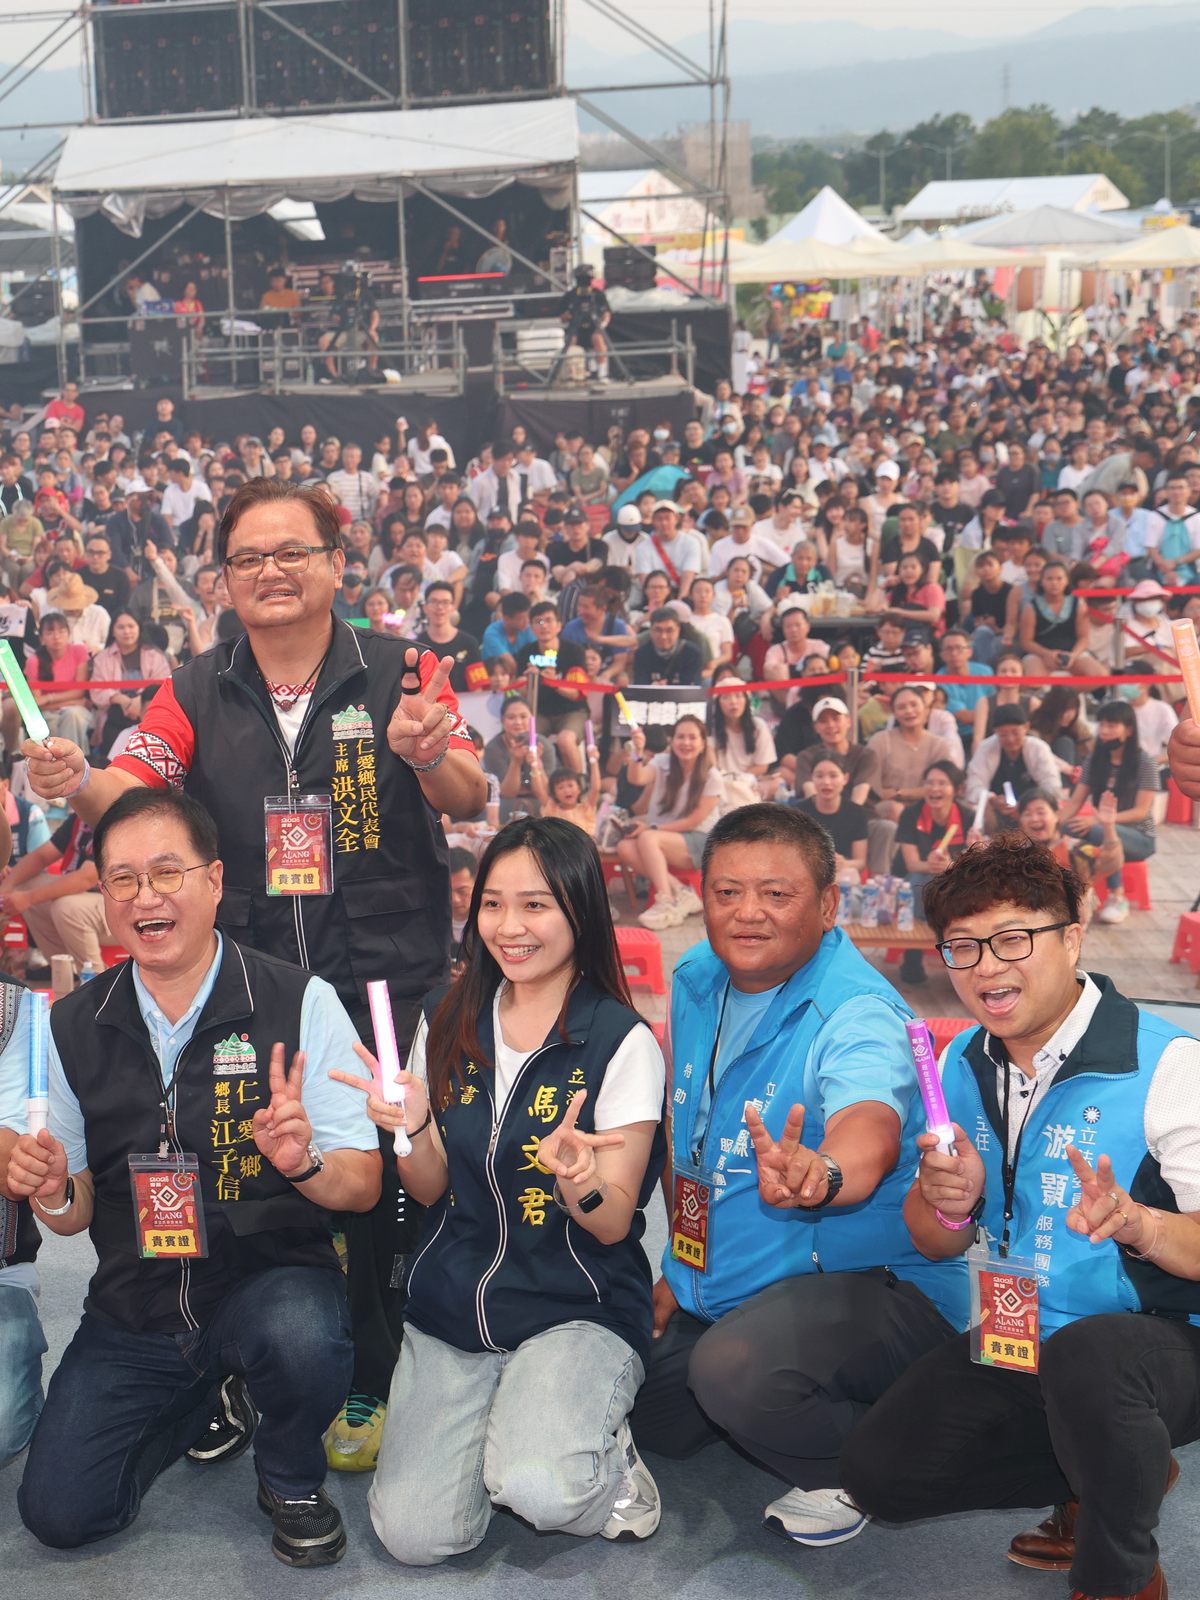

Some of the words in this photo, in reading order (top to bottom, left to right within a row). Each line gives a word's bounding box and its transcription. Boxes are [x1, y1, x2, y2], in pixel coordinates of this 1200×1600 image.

[334, 742, 349, 773] 主席
[356, 739, 381, 850] 仁愛鄉民代表會
[331, 776, 360, 853] 洪文全
[214, 1081, 231, 1115] 鄉長
[236, 1080, 262, 1180] 仁愛鄉
[210, 1118, 241, 1201] 江子信
[1034, 1214, 1053, 1288] 服務團隊
